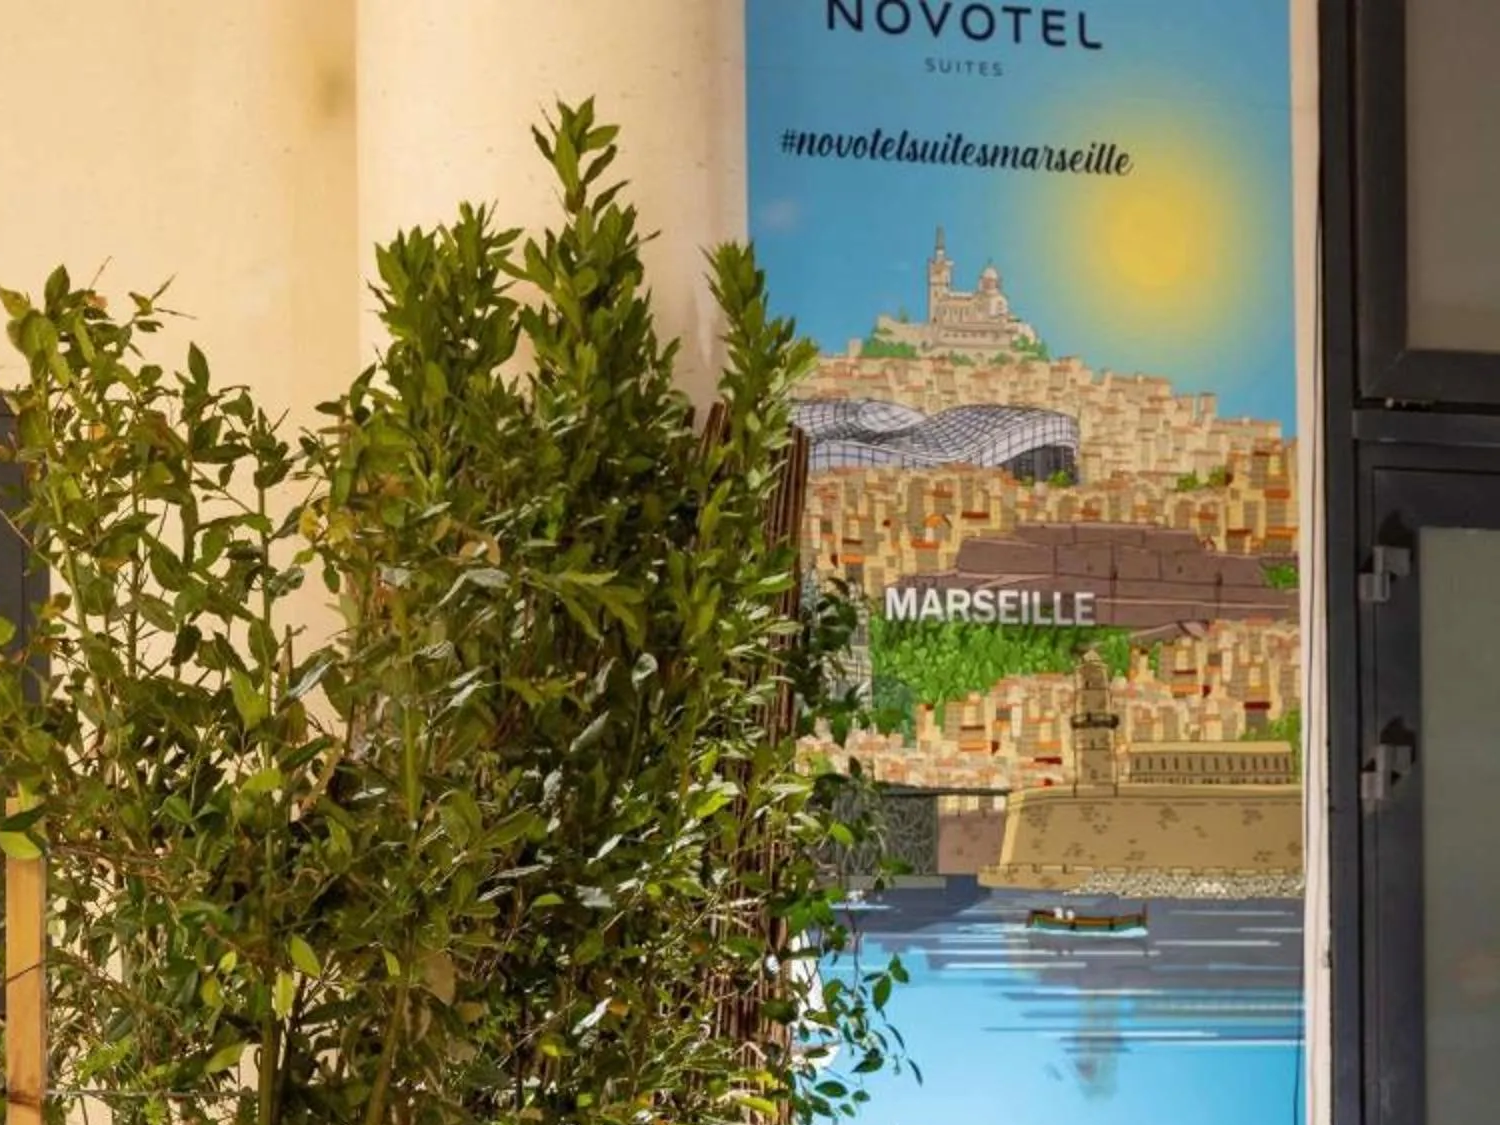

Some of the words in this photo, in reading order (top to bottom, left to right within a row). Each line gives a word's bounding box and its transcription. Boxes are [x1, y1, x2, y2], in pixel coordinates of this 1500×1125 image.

[826, 0, 1103, 50] NOVOTEL
[924, 57, 1004, 77] SUITES
[781, 128, 1134, 177] #novotelsuitesmarseille
[884, 587, 1096, 626] MARSEILLE
